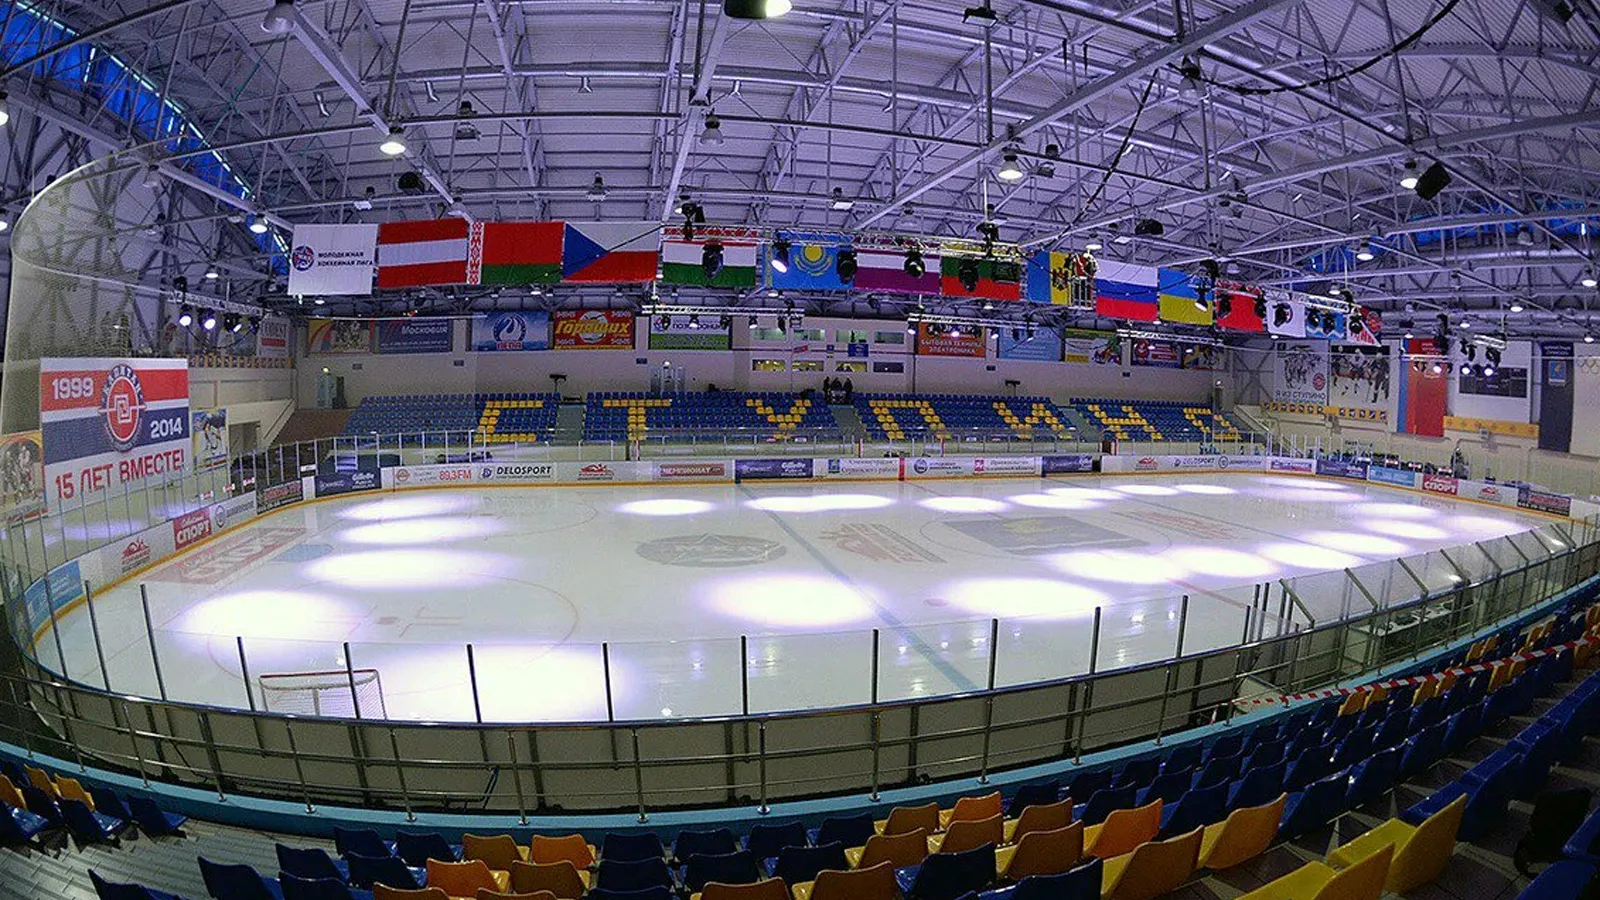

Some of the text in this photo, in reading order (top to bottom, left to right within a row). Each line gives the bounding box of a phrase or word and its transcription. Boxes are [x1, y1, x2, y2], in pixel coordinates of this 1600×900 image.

[52, 377, 94, 400] 1999
[150, 417, 183, 439] 2014
[55, 448, 185, 500] 15 ЛЕТ ВМЕСТЕ!
[496, 466, 552, 475] DELOSPORT
[781, 461, 806, 470] Gillette
[351, 472, 375, 482] Gillette
[1424, 481, 1456, 494] СПОРТ
[176, 519, 211, 545] СПОРТ
